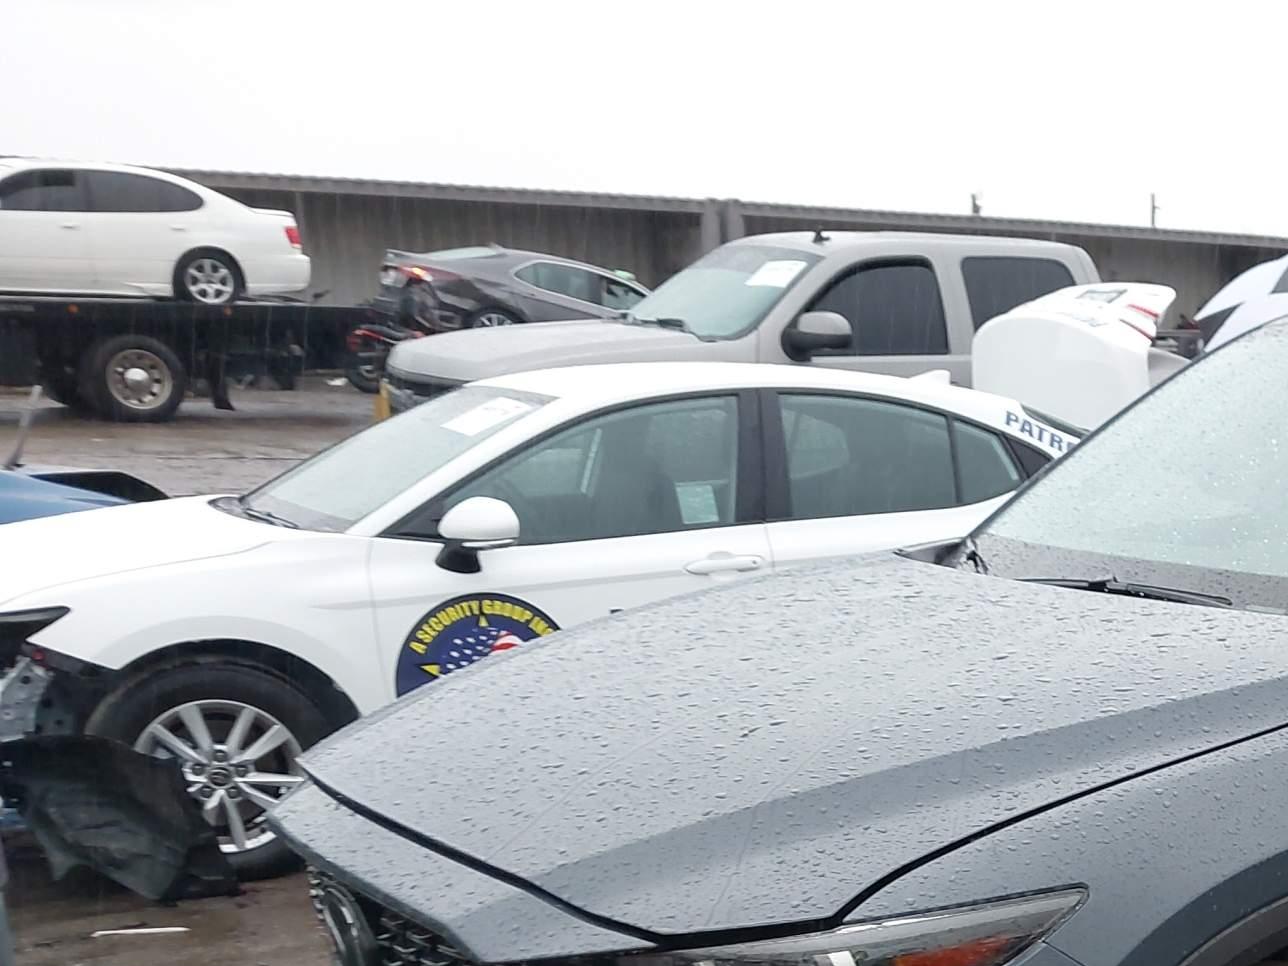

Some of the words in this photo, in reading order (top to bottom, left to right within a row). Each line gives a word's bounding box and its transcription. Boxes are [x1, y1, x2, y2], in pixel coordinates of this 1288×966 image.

[415, 600, 480, 643] SECURITY
[482, 600, 533, 623] GROUP
[409, 641, 427, 654] A
